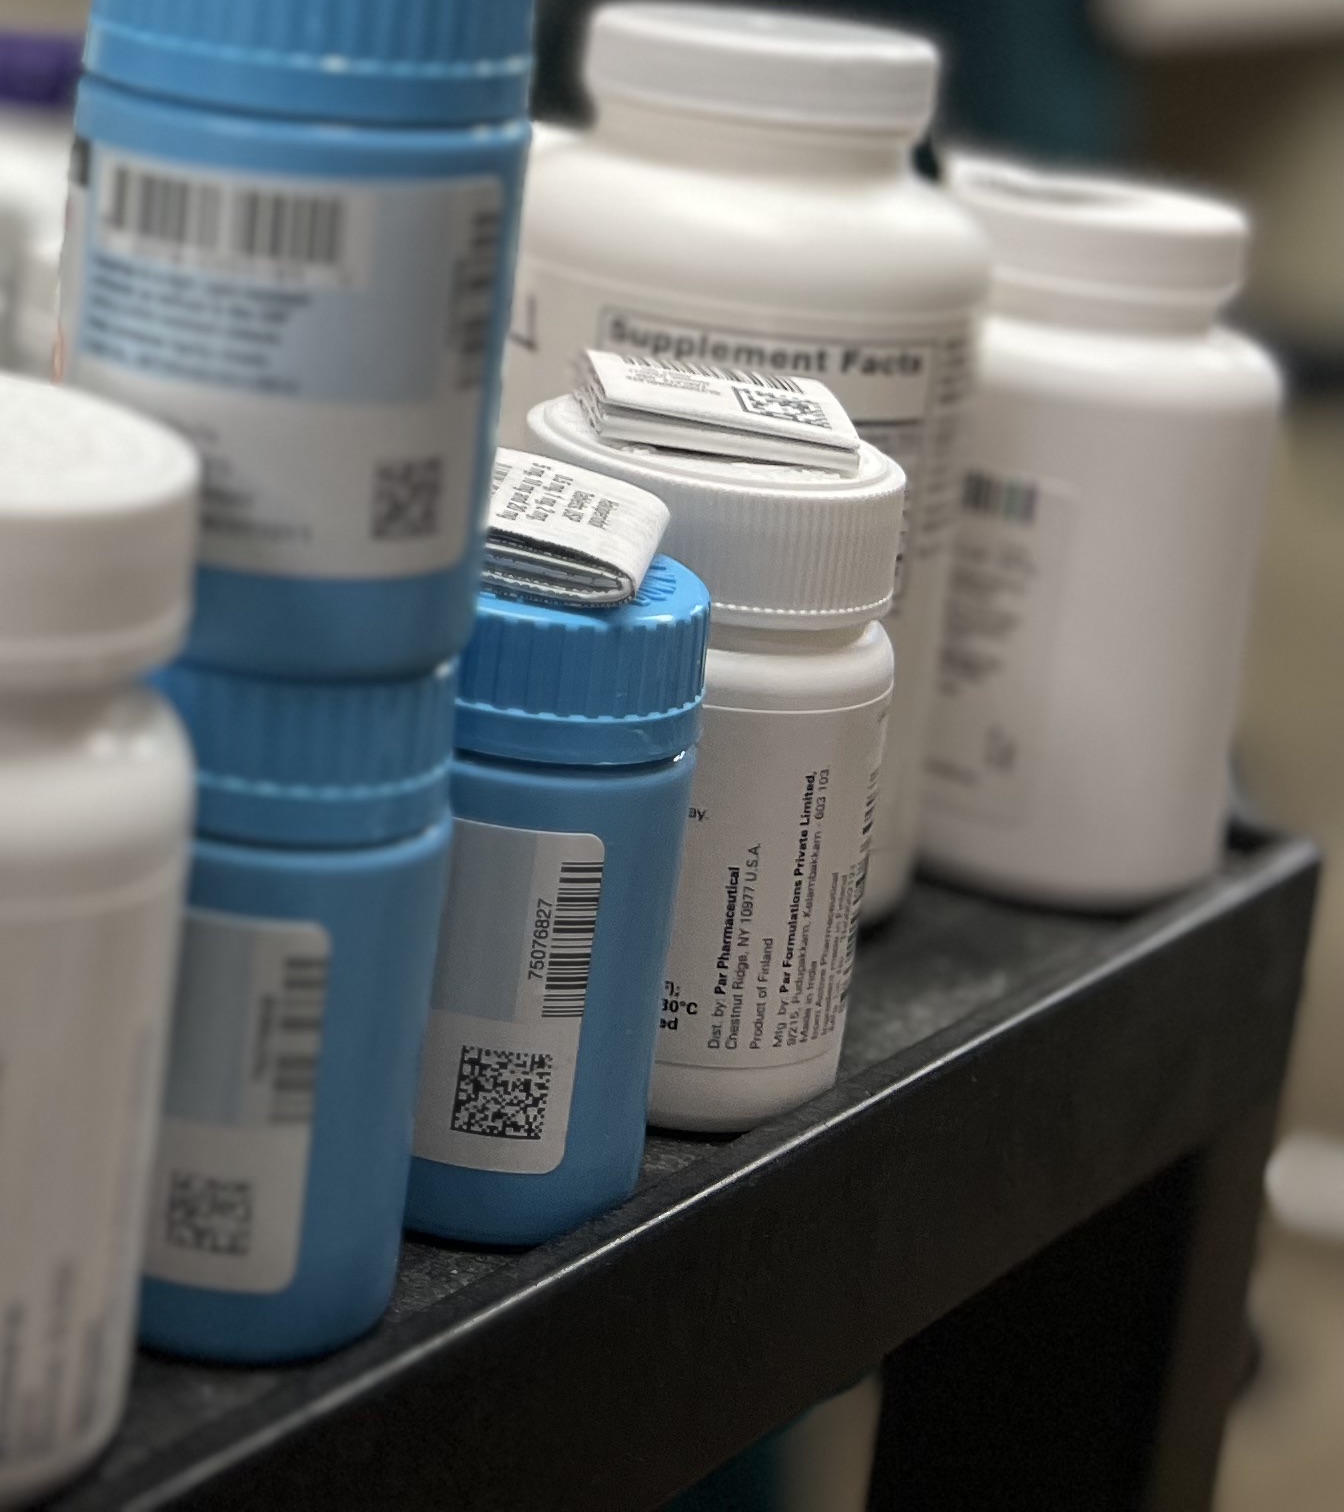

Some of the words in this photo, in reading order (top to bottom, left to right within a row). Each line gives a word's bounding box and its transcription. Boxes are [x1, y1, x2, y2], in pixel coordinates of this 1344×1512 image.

[608, 317, 830, 372] Supplement
[840, 346, 922, 376] Facts
[800, 770, 818, 827] Limited,
[793, 828, 809, 878] Private
[716, 866, 741, 970] Pharmaceutical
[740, 885, 756, 923] 10977
[782, 878, 803, 969] Formulations
[527, 897, 553, 980] 75076827
[737, 928, 750, 948] NY
[757, 937, 773, 983] Finland
[714, 972, 728, 996] Par
[758, 980, 768, 999] of
[779, 971, 791, 993] Par
[724, 993, 743, 1050] Chestnut
[749, 1000, 766, 1050] Product
